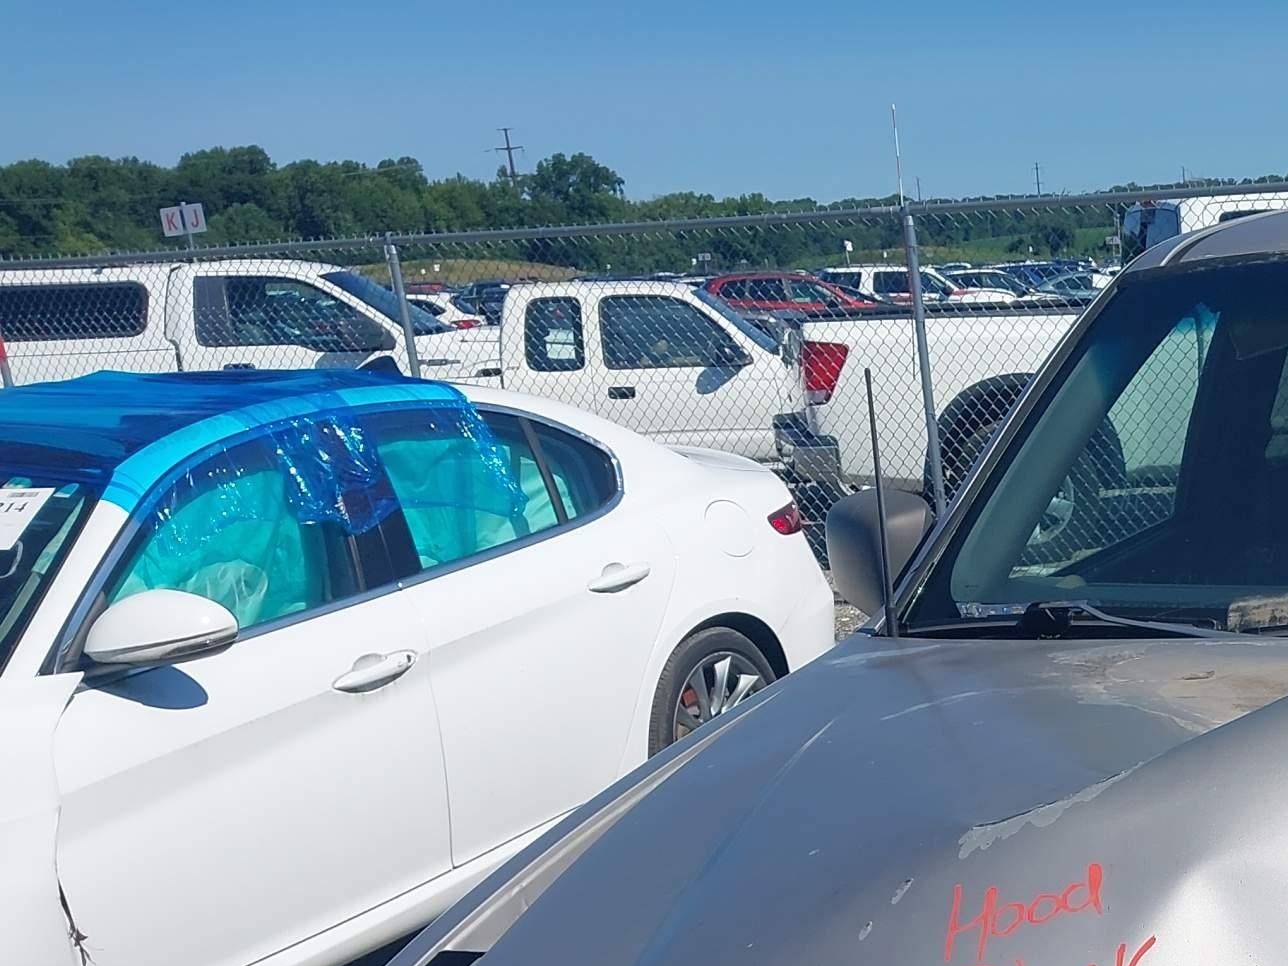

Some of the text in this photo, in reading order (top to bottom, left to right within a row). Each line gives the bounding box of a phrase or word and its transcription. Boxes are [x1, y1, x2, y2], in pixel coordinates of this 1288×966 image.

[166, 209, 199, 231] K J
[944, 863, 1103, 960] Hood
